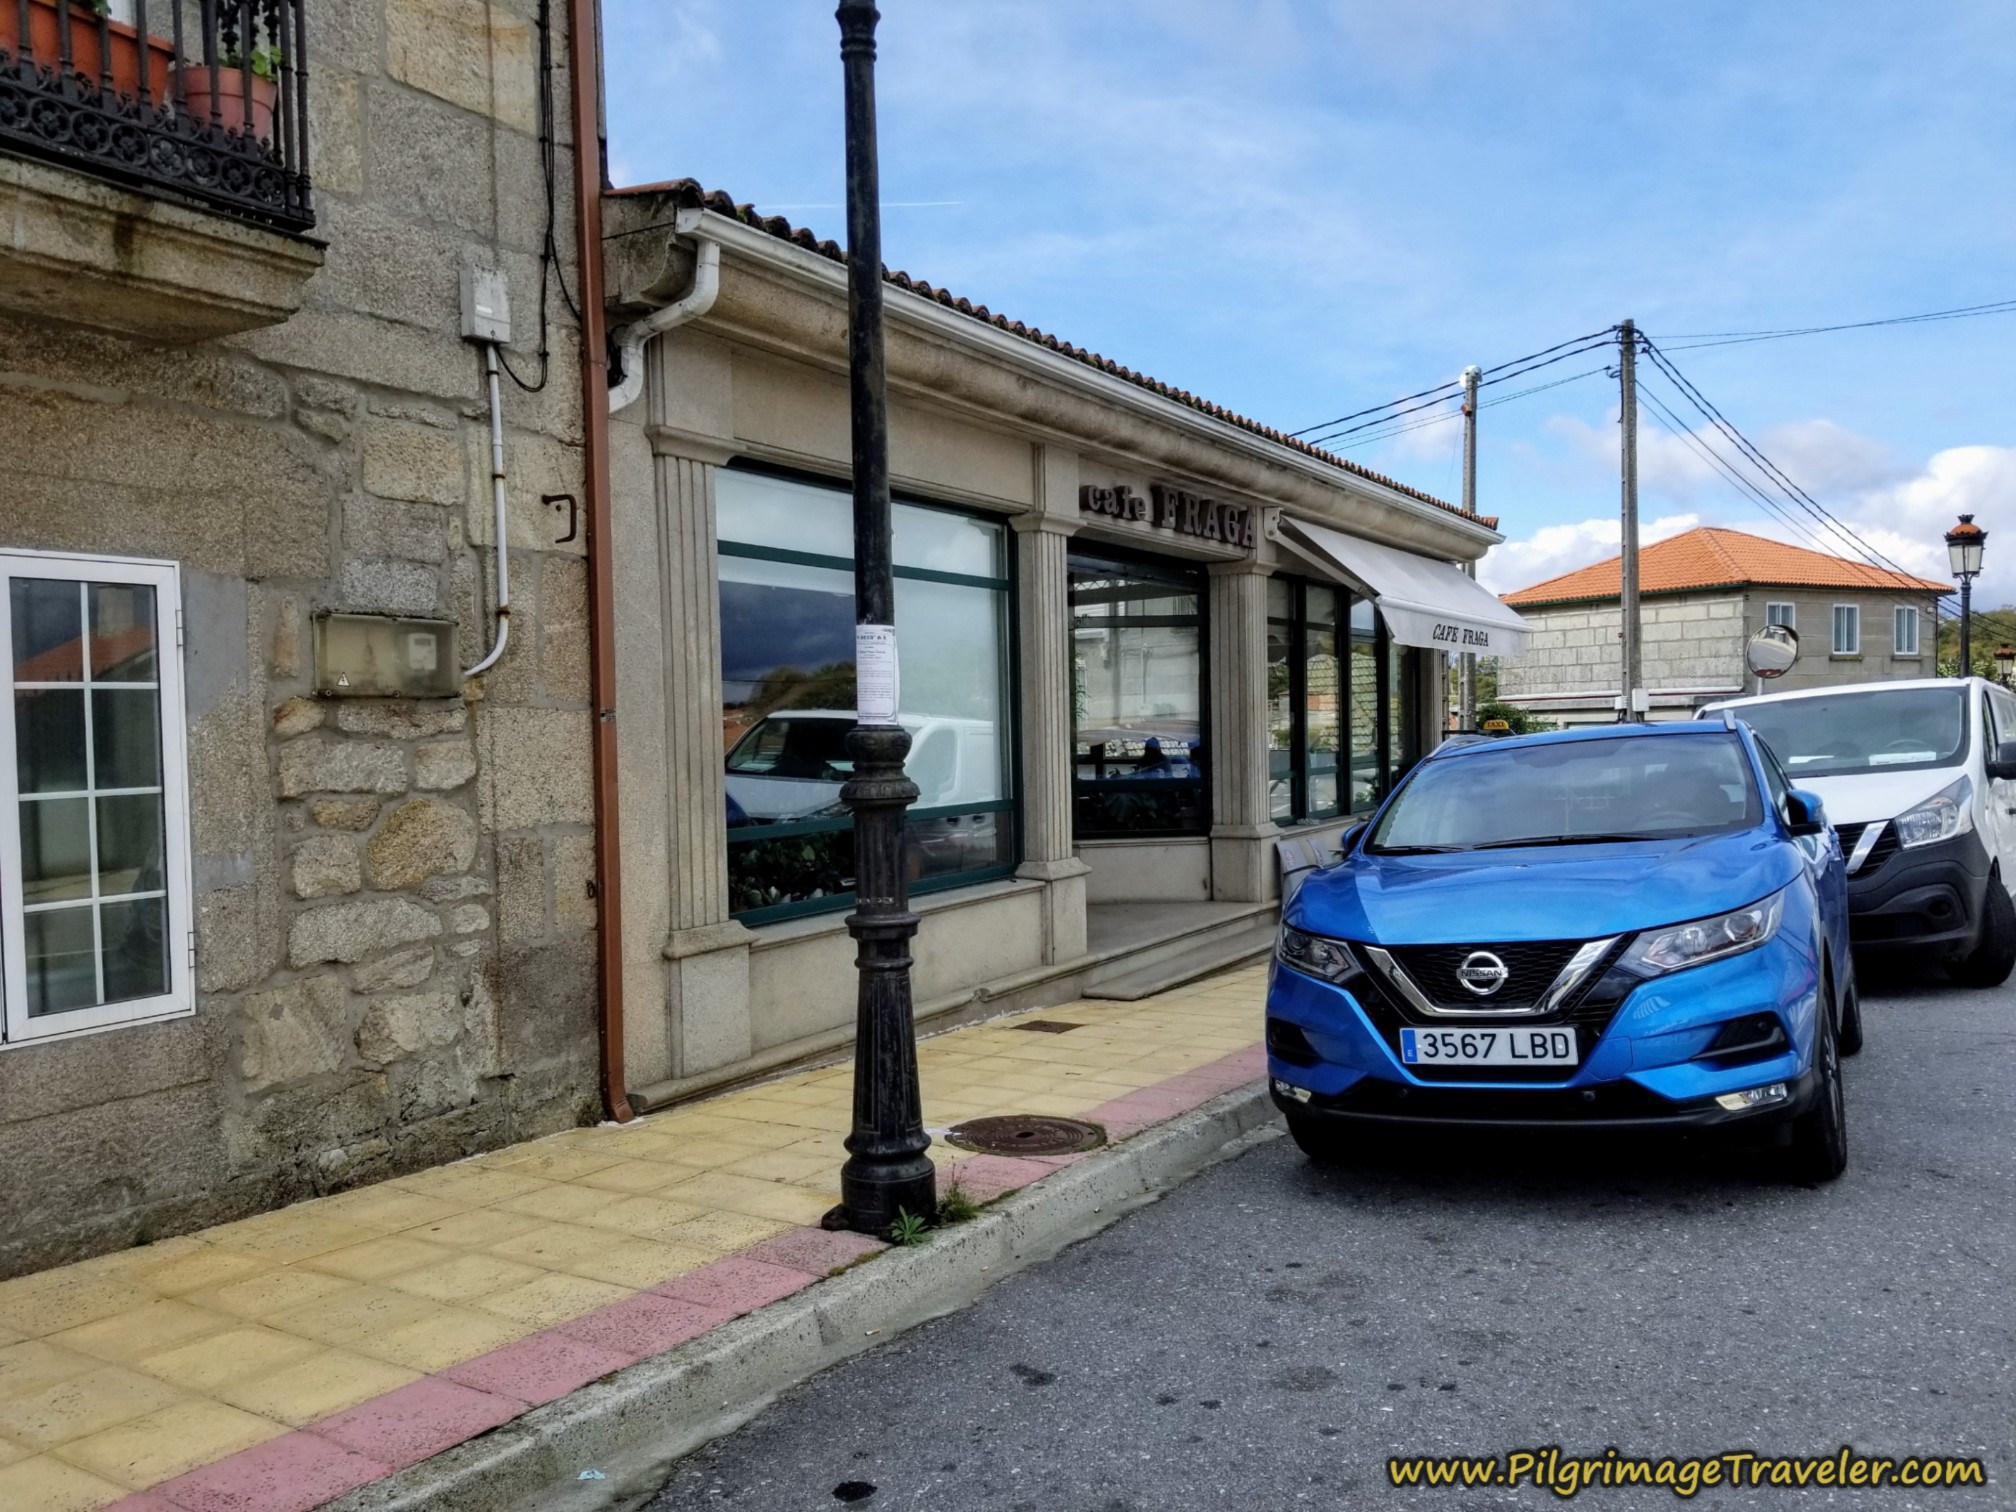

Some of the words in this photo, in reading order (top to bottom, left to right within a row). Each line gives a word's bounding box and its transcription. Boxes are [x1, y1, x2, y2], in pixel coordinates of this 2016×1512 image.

[1154, 486, 1257, 548] FRAGA
[1462, 628, 1489, 647] FRAGA
[1461, 969, 1502, 978] NISSAN
[1422, 1033, 1497, 1059] 3567
[1509, 1033, 1570, 1059] LBD
